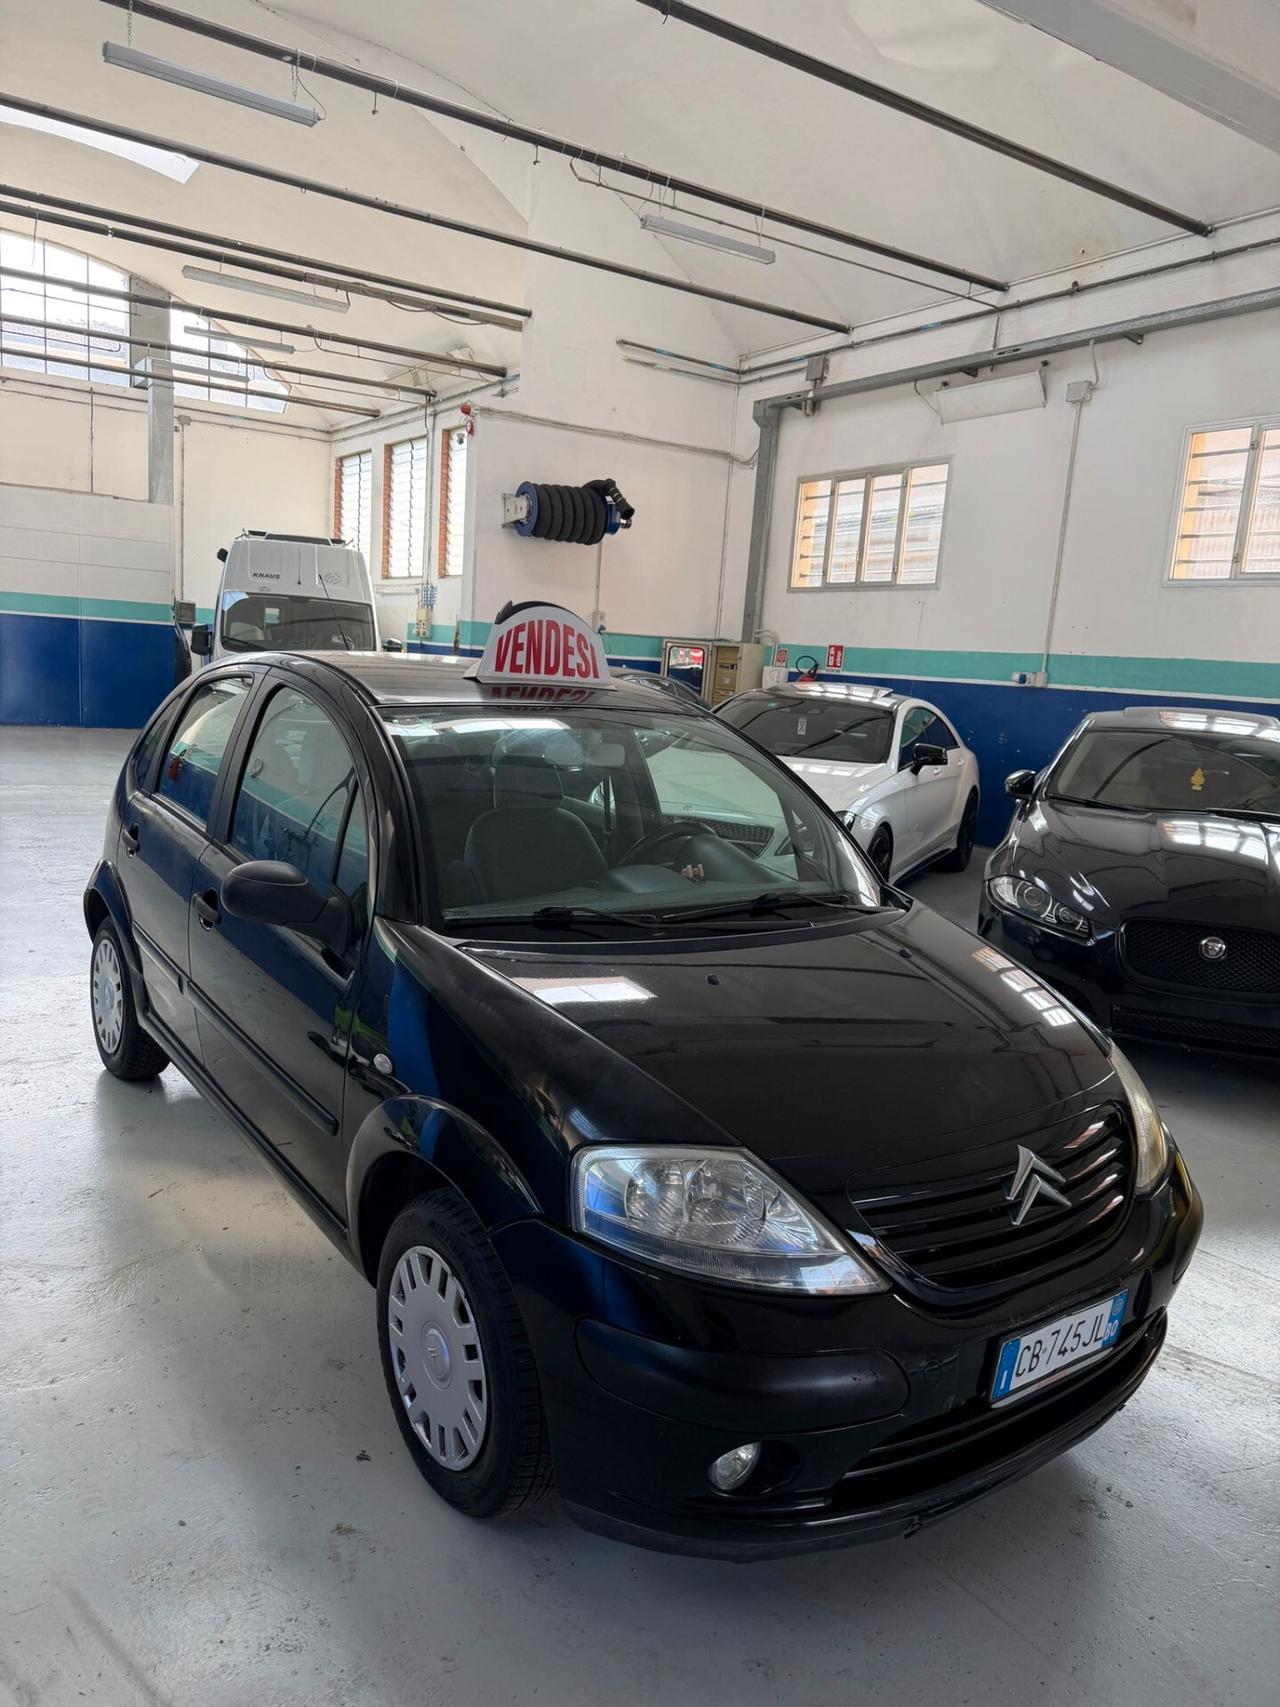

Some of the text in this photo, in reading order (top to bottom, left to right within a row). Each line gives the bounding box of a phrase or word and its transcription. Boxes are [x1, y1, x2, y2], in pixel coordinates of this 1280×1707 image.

[252, 571, 281, 580] KNAUS
[494, 619, 600, 679] VENDESI
[1103, 1319, 1119, 1341] BO
